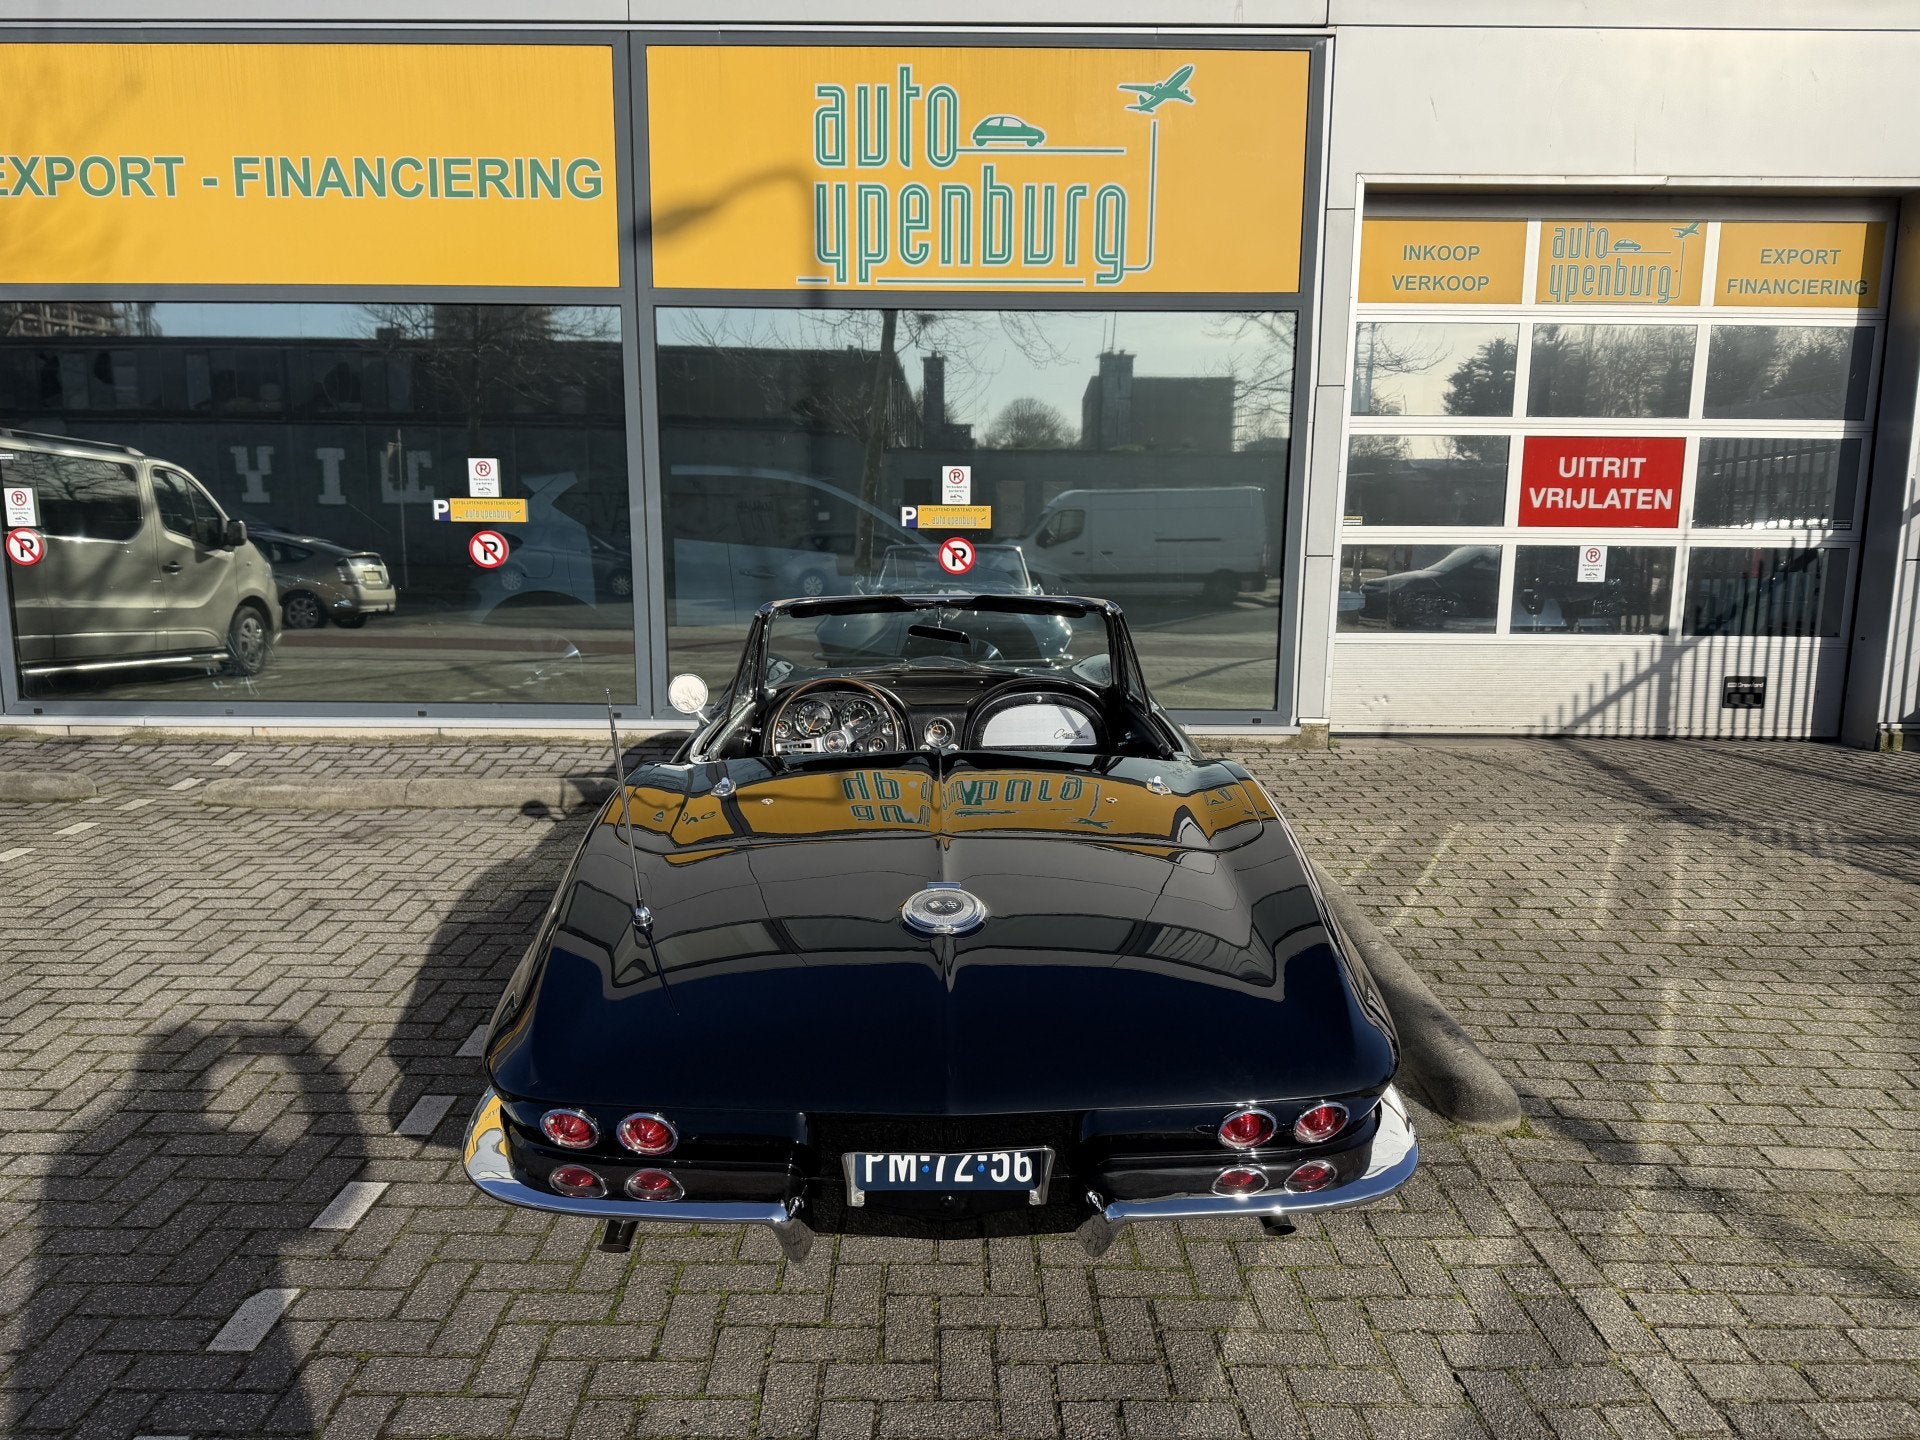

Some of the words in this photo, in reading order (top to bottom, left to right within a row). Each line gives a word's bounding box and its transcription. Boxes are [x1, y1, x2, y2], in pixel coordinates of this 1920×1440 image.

[813, 62, 960, 169] auto
[233, 156, 603, 200] FINANCIERING
[812, 163, 1128, 285] ypenburg
[1552, 221, 1609, 259] auto
[1402, 244, 1481, 262] INKOOP
[1760, 248, 1842, 265] EXPORT
[1391, 274, 1490, 292] VERKOOP
[1549, 257, 1672, 304] ypenburg
[1726, 278, 1869, 296] FINANCIERING
[1558, 456, 1648, 479] UITRIT
[433, 499, 450, 521] P
[1529, 487, 1674, 510] VRIJLATEN
[901, 506, 917, 527] P
